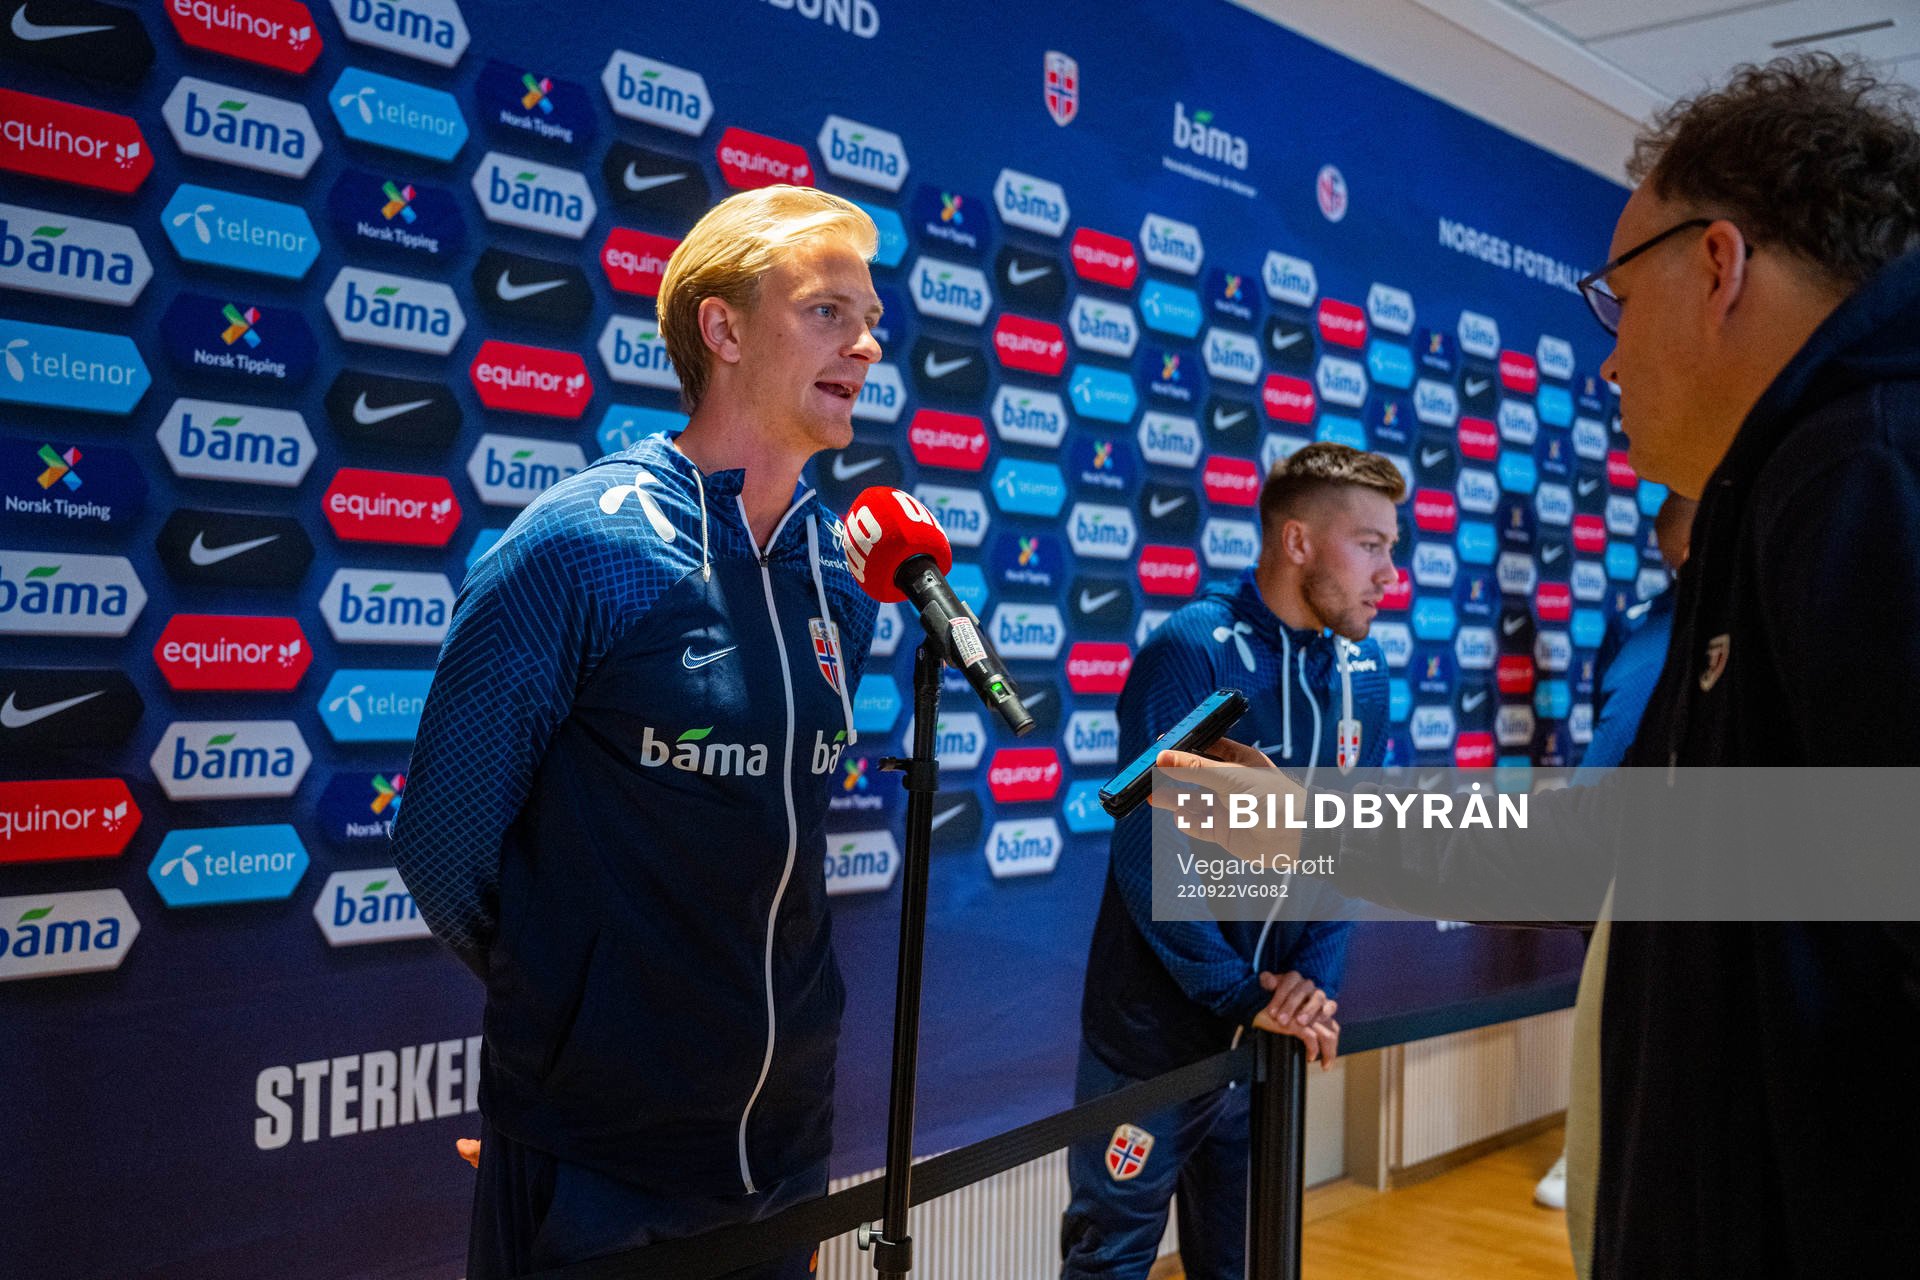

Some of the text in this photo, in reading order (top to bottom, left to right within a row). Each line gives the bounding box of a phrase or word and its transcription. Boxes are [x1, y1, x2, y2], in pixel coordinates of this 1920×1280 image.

[618, 63, 701, 120] bama
[184, 92, 306, 159] bama
[377, 99, 456, 136] telenor
[1173, 101, 1249, 171] bama
[0, 119, 109, 159] quinor
[831, 129, 899, 177] bama
[721, 145, 789, 179] equinor
[490, 166, 584, 222] bama
[1004, 182, 1060, 222] bama
[0, 219, 134, 286] bama
[217, 216, 308, 252] telenor
[357, 221, 439, 253] Norsk Tipping
[605, 247, 667, 276] equin
[1438, 216, 1591, 296] NORGES FOTBALL
[344, 281, 452, 337] bama
[921, 268, 982, 312] bama
[1079, 311, 1130, 342] bama
[31, 351, 137, 386] telenor
[194, 350, 287, 378] Norsk Tipping
[614, 328, 668, 372] bam
[476, 362, 562, 392] equinor
[1003, 397, 1058, 435] bama
[178, 413, 301, 468] bama
[485, 447, 580, 490] bam
[5, 496, 111, 522] Norsk Tipping
[329, 490, 428, 520] equinor
[1077, 511, 1128, 547] bama
[339, 582, 446, 627] bama
[1000, 615, 1056, 645] bama
[162, 637, 274, 669] equinor
[367, 691, 424, 716] telen
[172, 732, 294, 781] bama
[640, 726, 768, 776] bama
[346, 821, 384, 838] Norsk
[204, 851, 296, 876] telenor
[995, 836, 1052, 863] bama
[332, 885, 418, 928] bam
